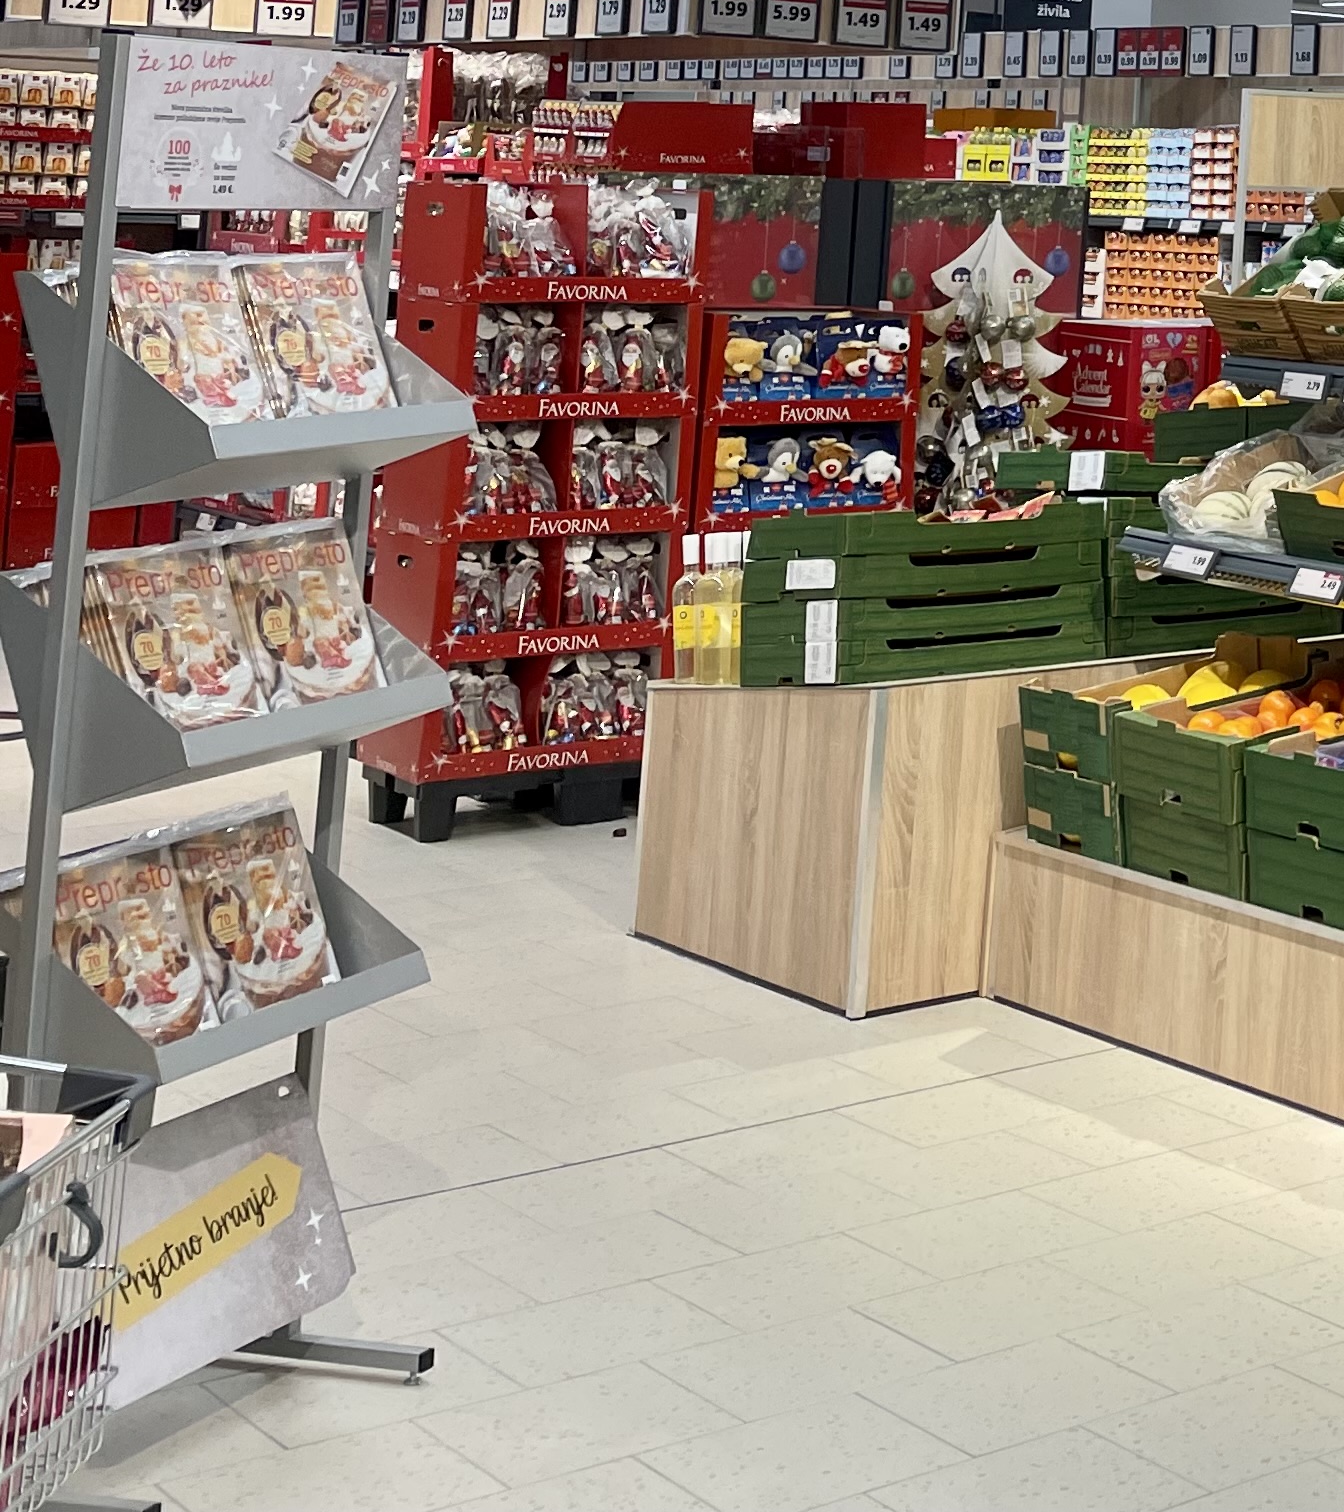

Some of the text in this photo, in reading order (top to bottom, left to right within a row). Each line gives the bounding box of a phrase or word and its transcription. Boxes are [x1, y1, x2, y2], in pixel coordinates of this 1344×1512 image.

[266, 5, 305, 21] 1.99
[448, 7, 464, 21] 2.29
[492, 6, 509, 21] 2.29
[549, 2, 567, 18] 2.99
[602, 0, 619, 16] 1.79
[711, 0, 748, 18] 1.99
[772, 4, 811, 22] 5.99
[1037, 1, 1071, 19] živila
[845, 11, 880, 29] 1.49
[907, 16, 941, 33] 1.49
[136, 48, 238, 72] Že 10. leto
[1234, 52, 1248, 63] 1.13
[163, 70, 275, 98] za praznike!
[168, 139, 191, 155] 100
[659, 152, 706, 164] FAVORINA
[547, 281, 628, 301] FAVORINA
[538, 399, 620, 418] FAVORINA
[780, 404, 851, 423] FAVORINA
[529, 517, 611, 536] FAVORINA
[1192, 556, 1207, 567] 1.99
[140, 640, 156, 655] 70
[518, 634, 600, 655] FAVORINA
[507, 750, 590, 772] FAVORINA
[116, 1172, 280, 1306] Prijetno branje!
